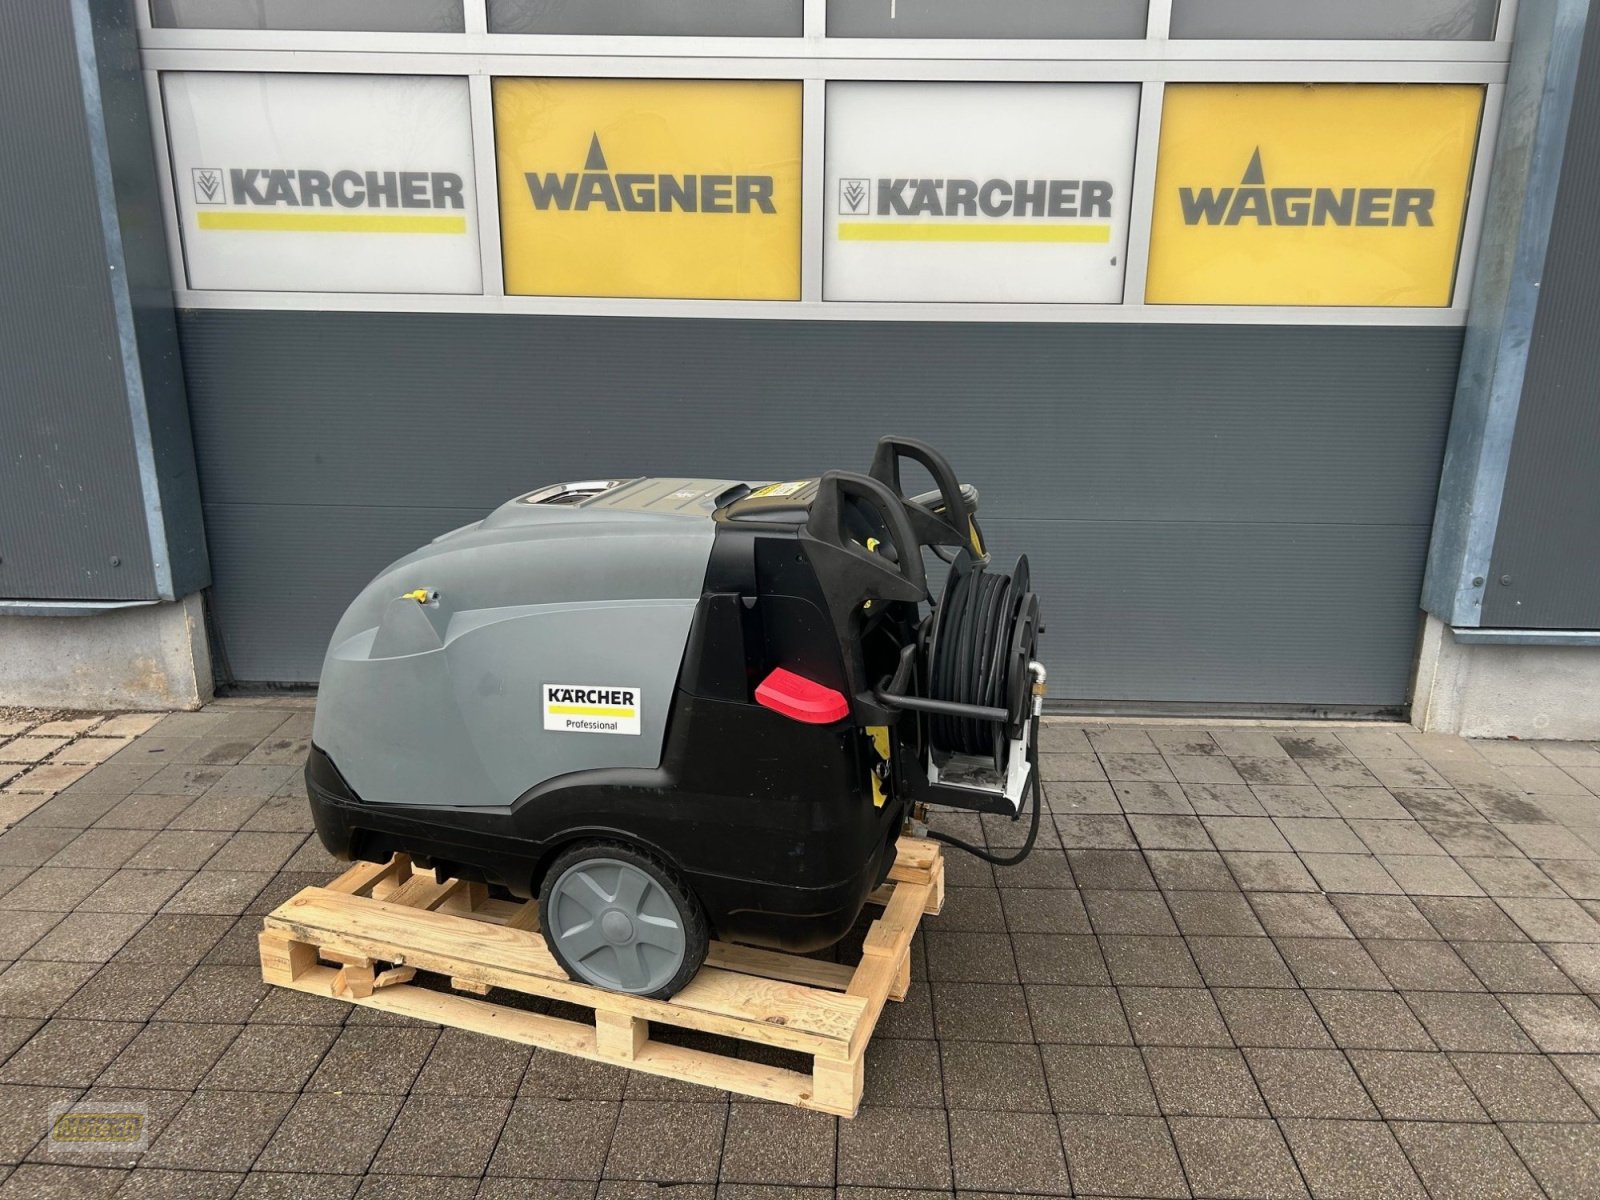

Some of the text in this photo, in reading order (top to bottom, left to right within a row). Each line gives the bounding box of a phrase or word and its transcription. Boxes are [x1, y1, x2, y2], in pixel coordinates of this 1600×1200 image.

[229, 168, 465, 209] KÄRCHER
[524, 130, 777, 214] WAGNER
[1178, 145, 1434, 227] WAGNER
[877, 178, 1113, 218] KÄRCHER
[548, 688, 634, 706] KÄRCHER
[566, 719, 618, 730] Professional
